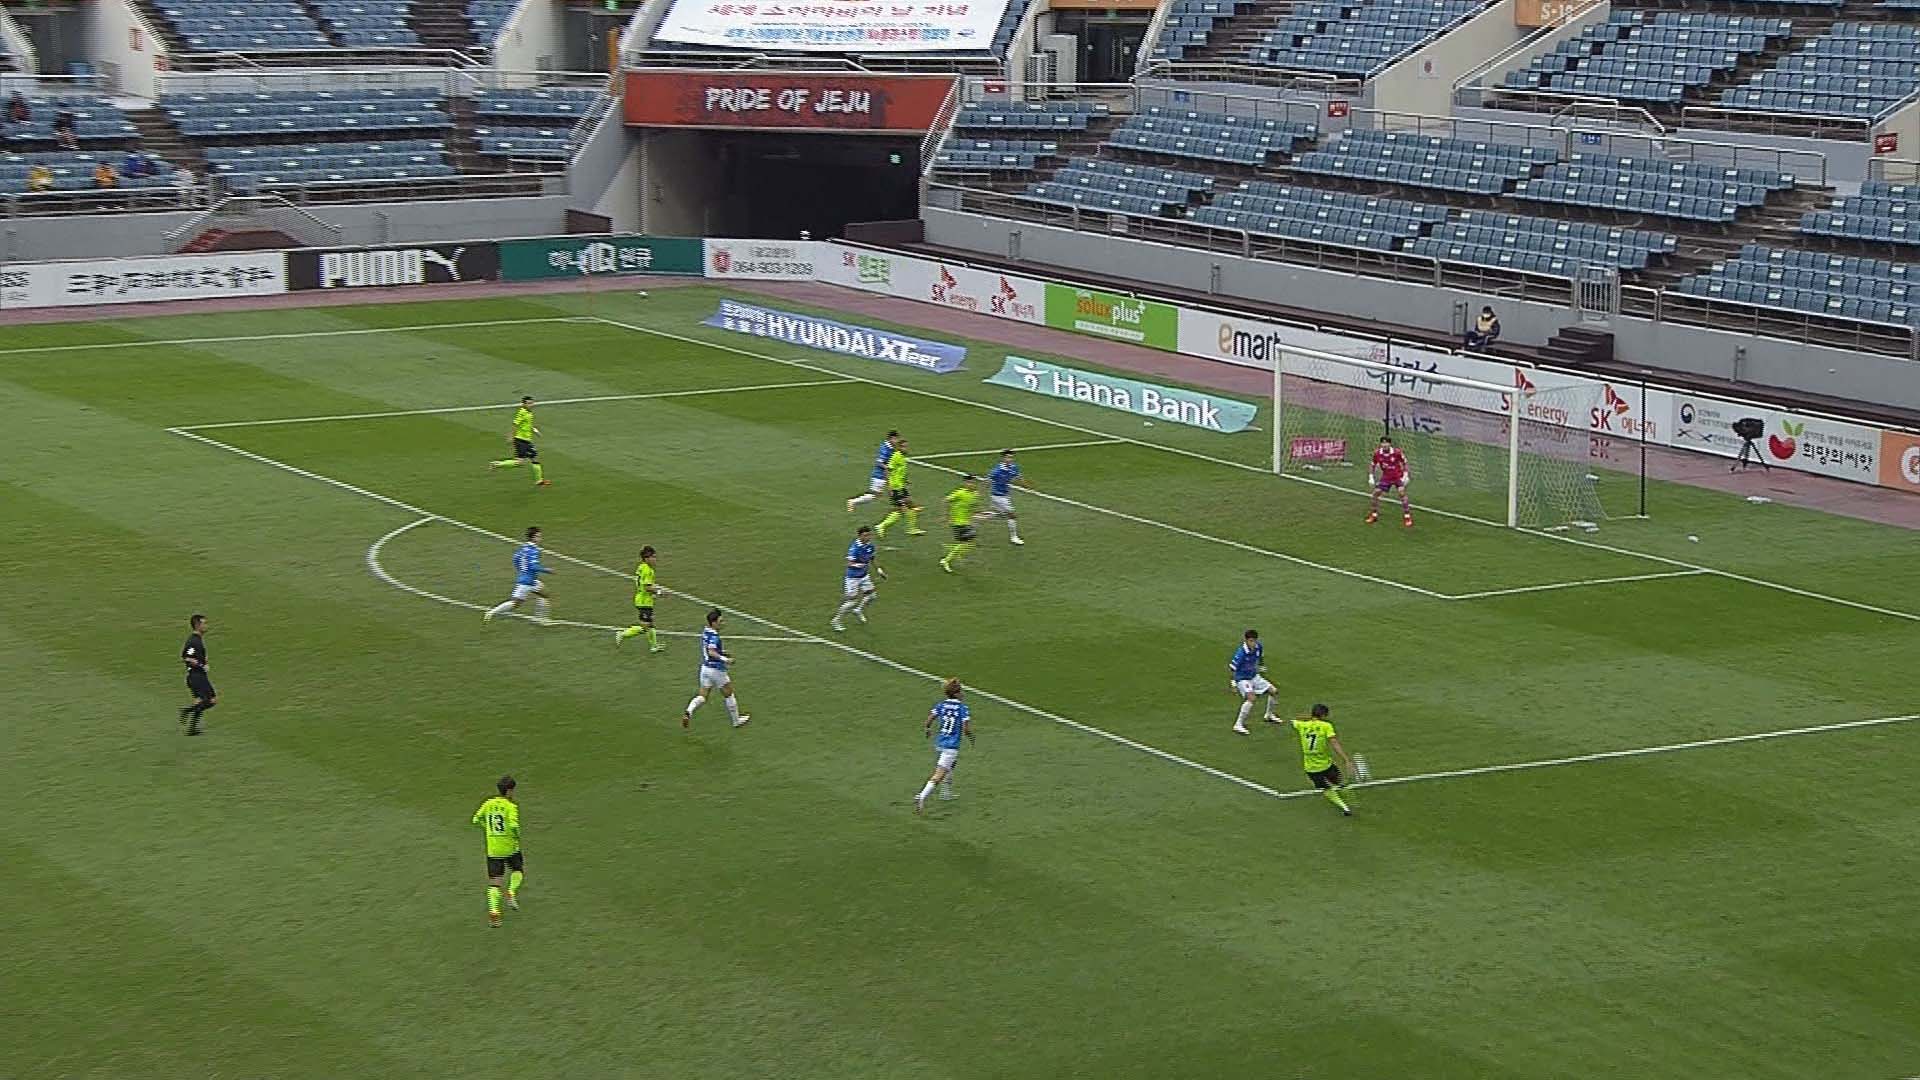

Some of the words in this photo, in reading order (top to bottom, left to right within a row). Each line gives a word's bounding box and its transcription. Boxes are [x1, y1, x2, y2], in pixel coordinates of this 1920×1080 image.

[707, 5, 758, 17] 세계
[922, 5, 969, 18] 기념
[703, 86, 772, 112] PRIDE
[777, 88, 811, 111] OF
[813, 88, 873, 114] JEJU
[319, 249, 426, 288] PUMA
[842, 251, 856, 268] SK
[931, 284, 946, 303] SK
[949, 293, 978, 311] energy
[991, 295, 1006, 315] SK
[766, 314, 875, 358] HYUNDAI
[876, 339, 942, 368] XTeer
[1218, 322, 1280, 361] emart
[1053, 371, 1133, 412] Hana
[1142, 388, 1222, 431] Bank
[1527, 401, 1568, 425] energy
[1590, 407, 1612, 431] SK
[1621, 416, 1657, 439] 에너지
[1802, 442, 1874, 473] 희망의씨앗
[1306, 733, 1318, 753] 7
[488, 815, 506, 834] 13
